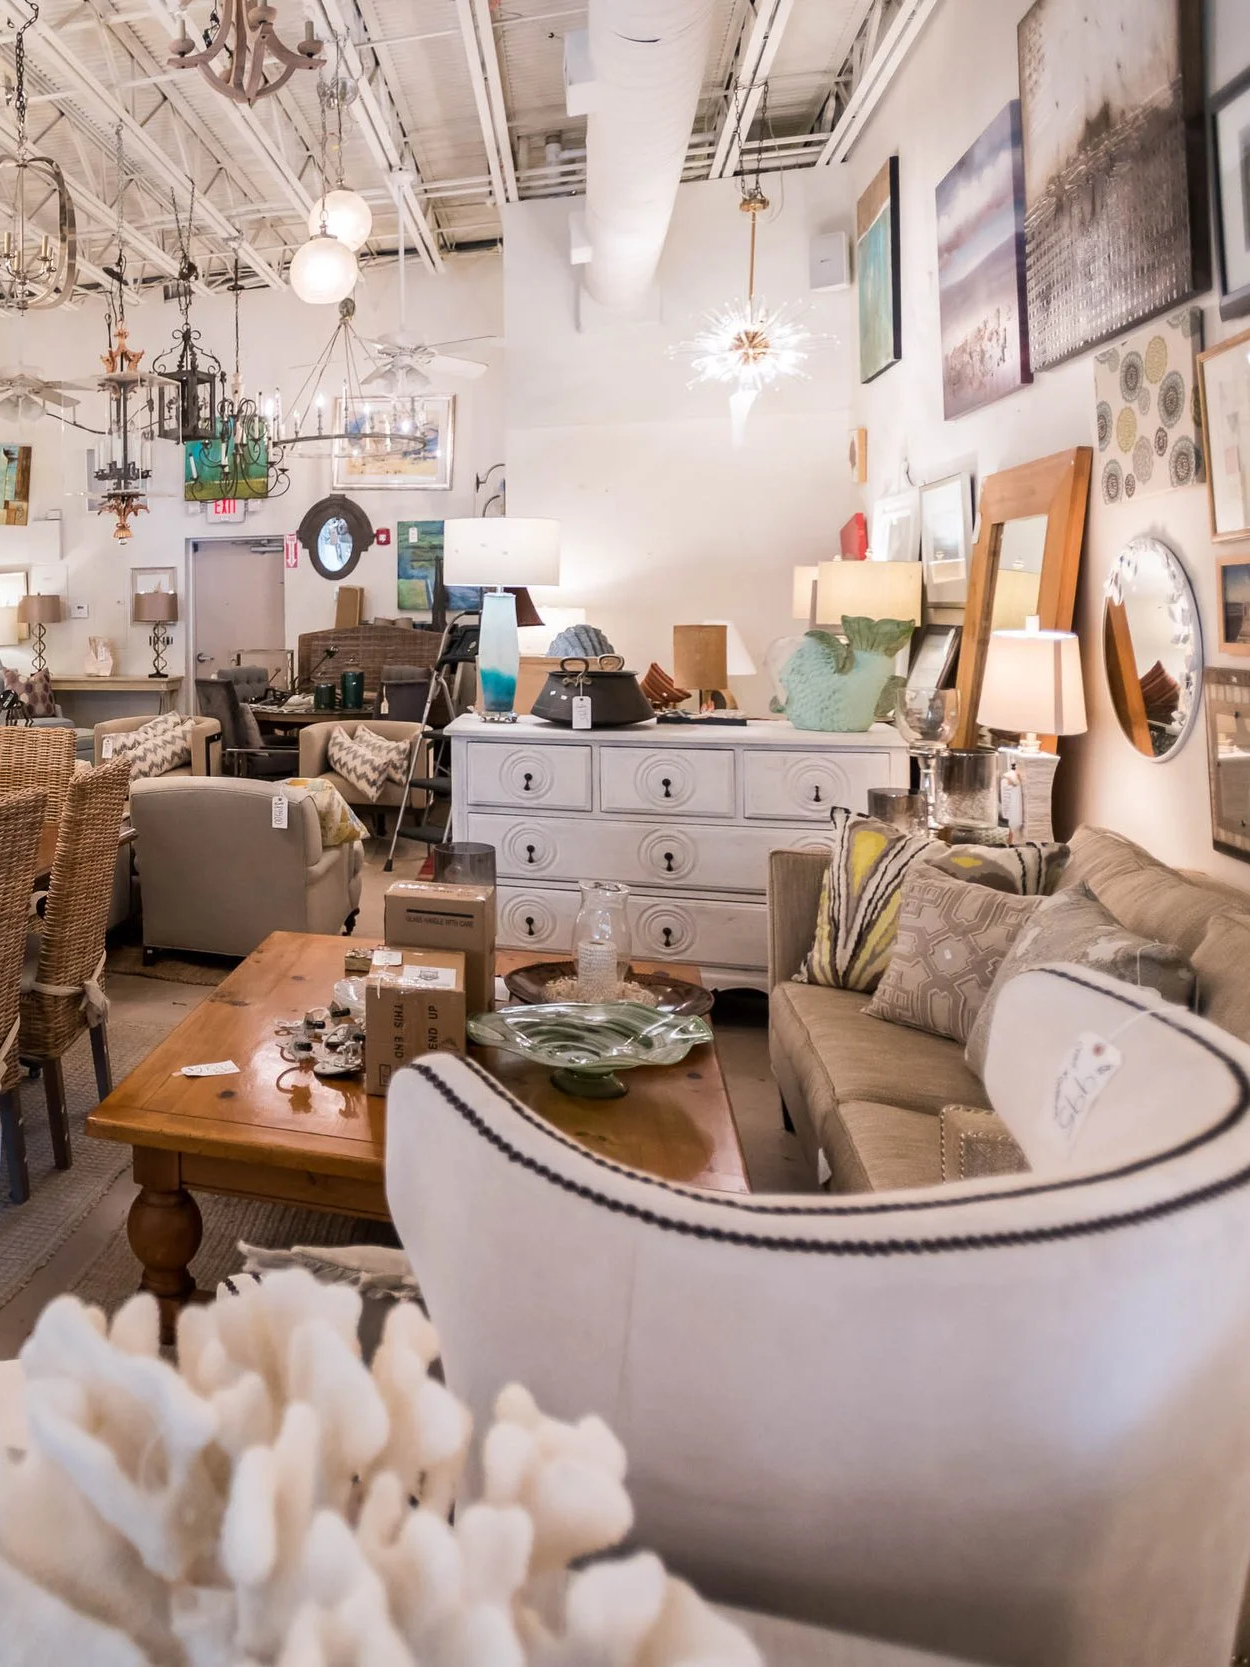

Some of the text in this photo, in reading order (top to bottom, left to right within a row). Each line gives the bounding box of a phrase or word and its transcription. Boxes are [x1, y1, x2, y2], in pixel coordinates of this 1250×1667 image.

[214, 498, 236, 514] EXIT
[459, 920, 475, 928] CARE
[394, 1003, 404, 1059] THIS END
[428, 1005, 438, 1050] END UP
